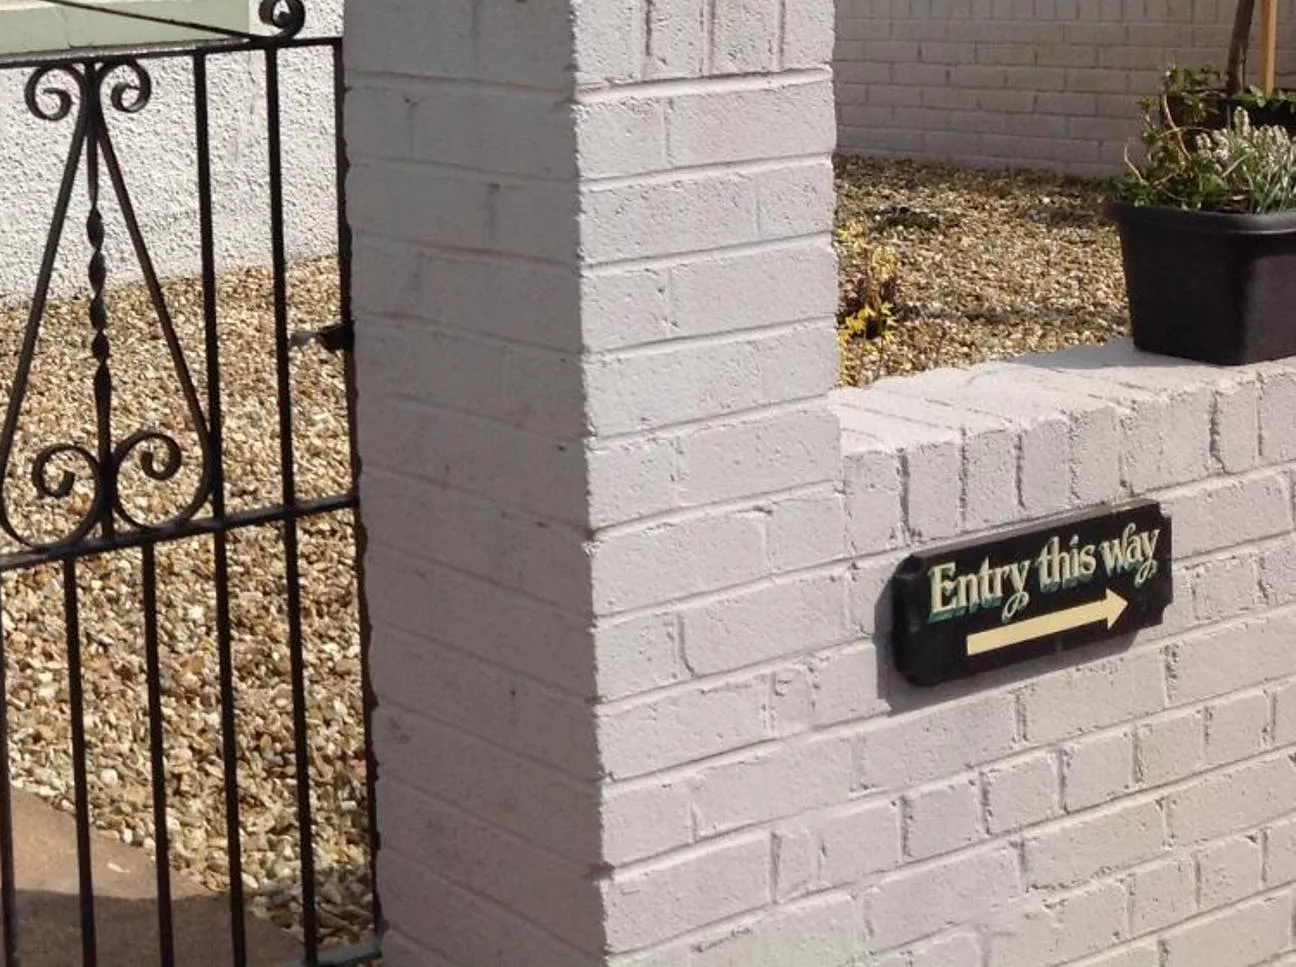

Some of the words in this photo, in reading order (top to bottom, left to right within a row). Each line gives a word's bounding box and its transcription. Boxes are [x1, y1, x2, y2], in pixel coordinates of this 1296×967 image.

[928, 556, 1031, 623] Entry
[1035, 535, 1096, 592] this
[1100, 522, 1160, 587] way
